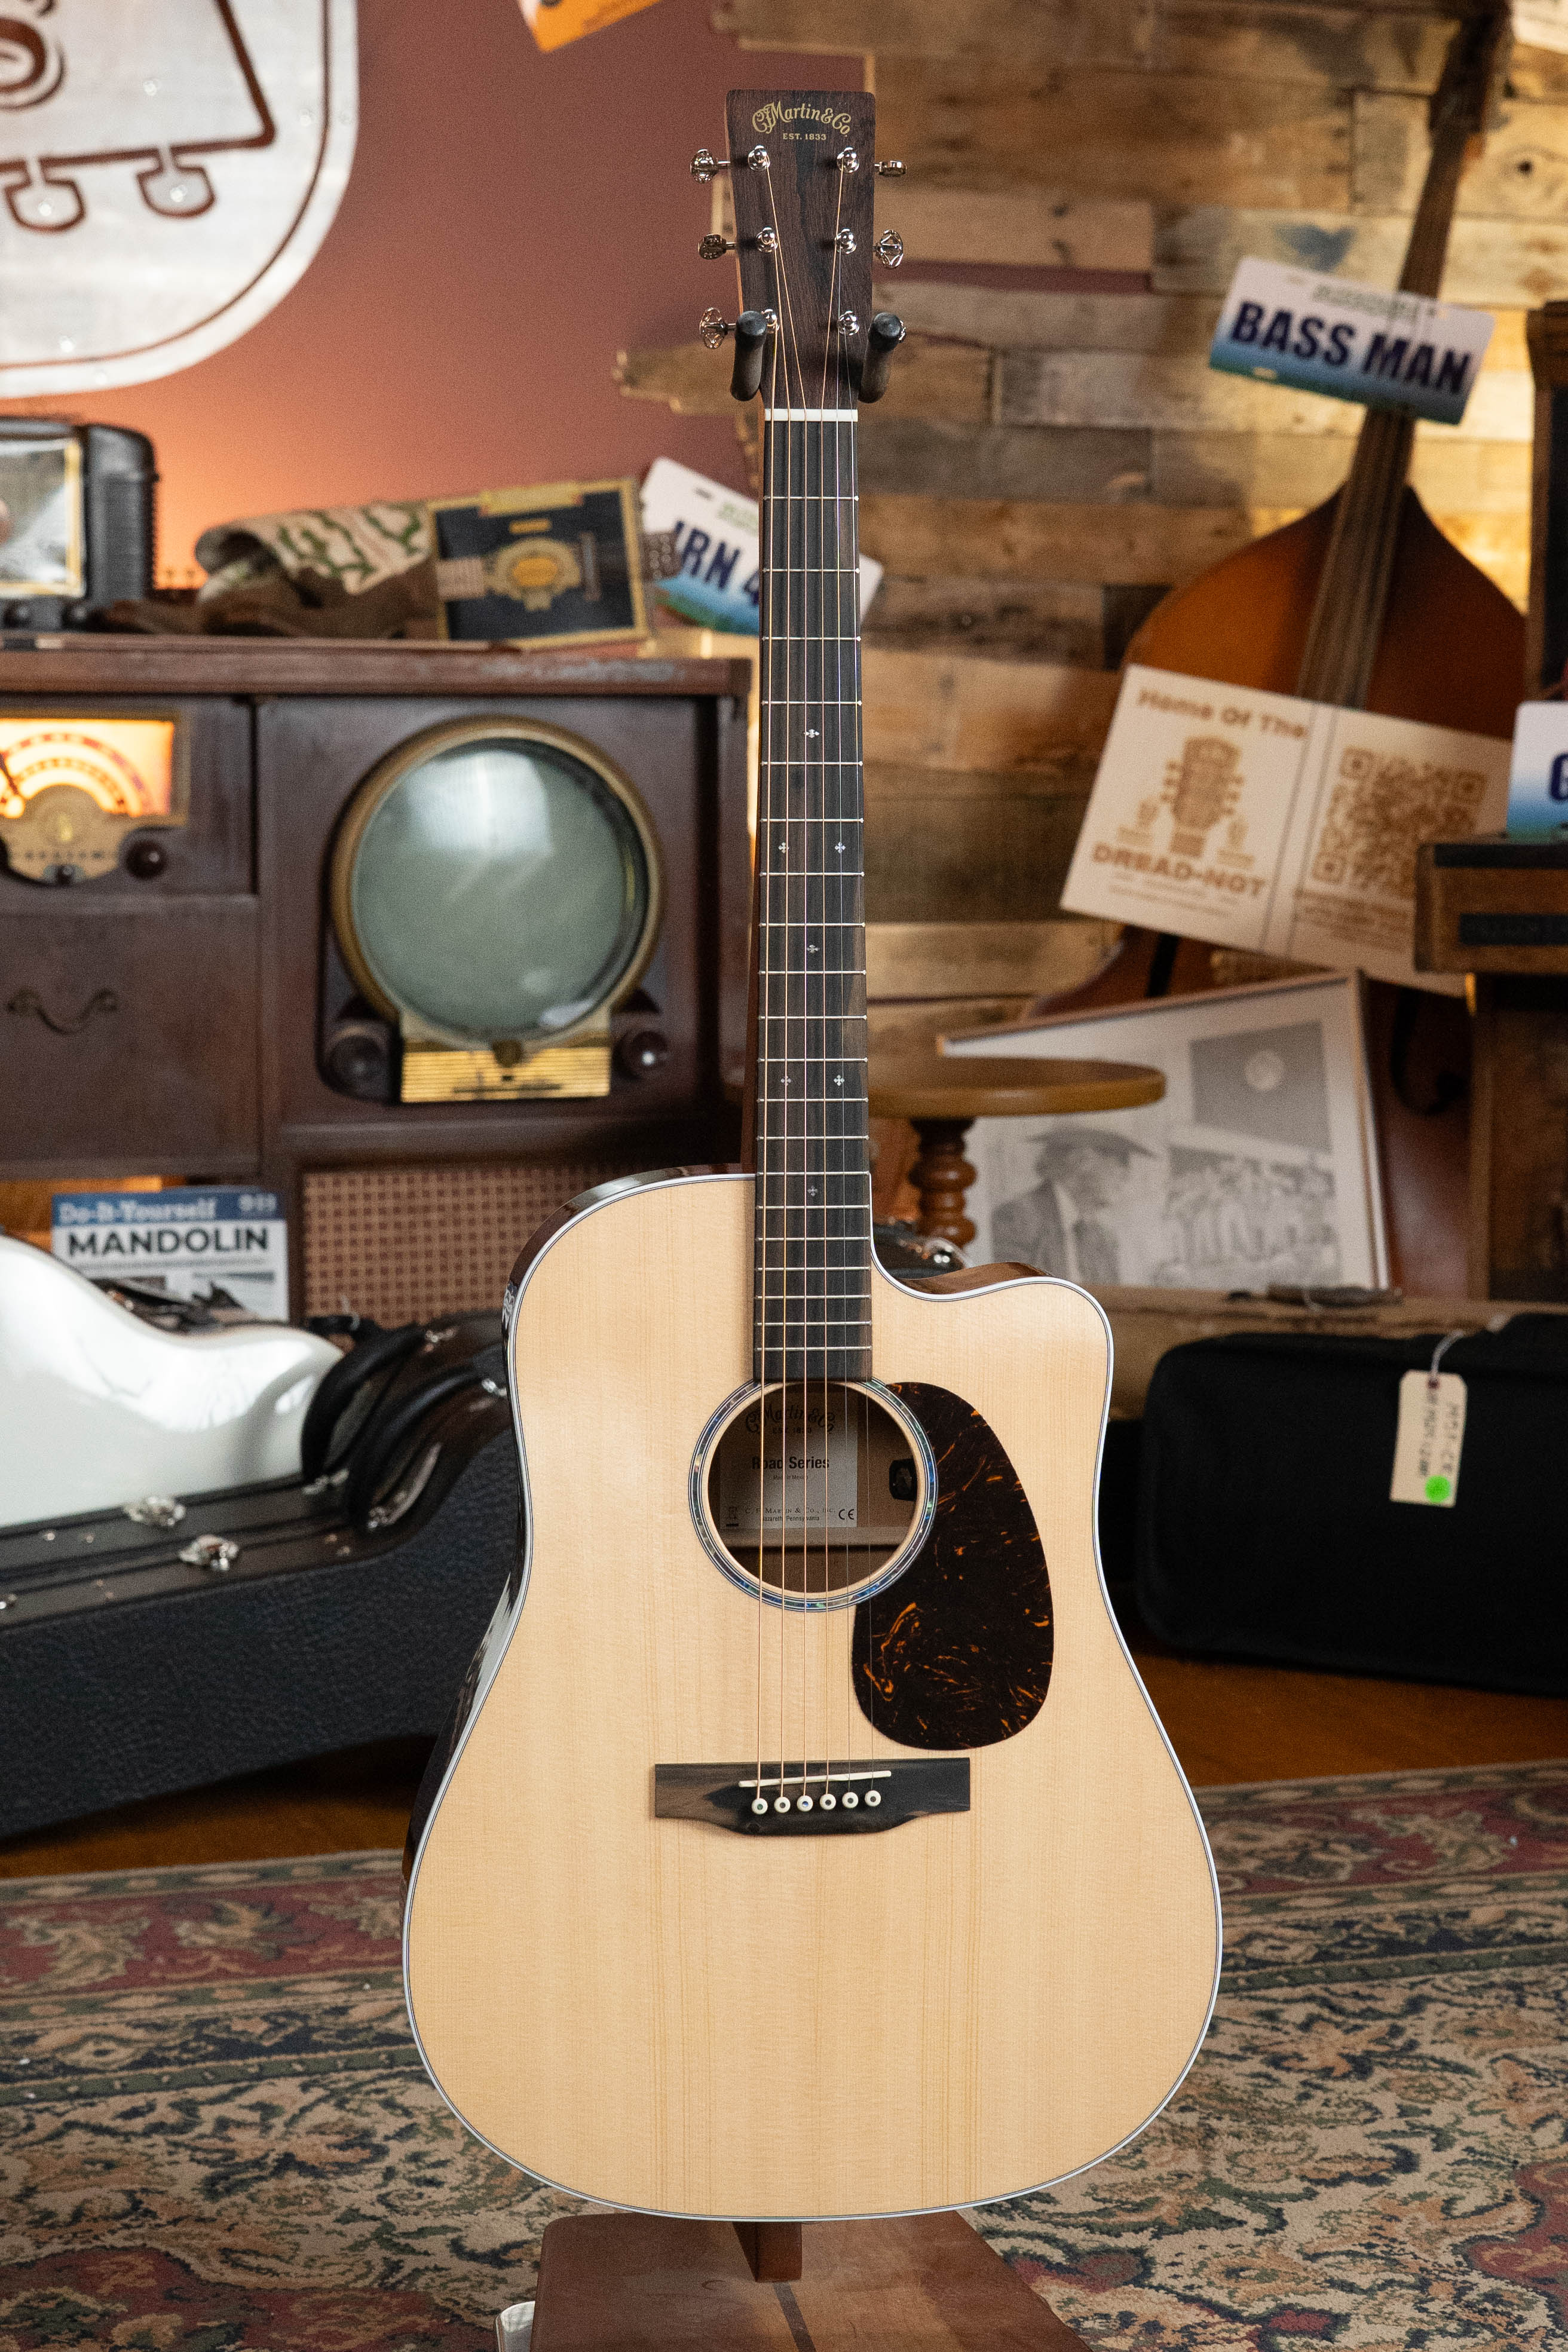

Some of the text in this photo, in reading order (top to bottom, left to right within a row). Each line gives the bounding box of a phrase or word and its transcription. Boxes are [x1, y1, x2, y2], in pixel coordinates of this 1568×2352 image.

[1232, 301, 1356, 367] BASS
[1362, 332, 1472, 394] MAN
[68, 1227, 268, 1256] MANDOLIN
[752, 1456, 829, 1469] Road Series
